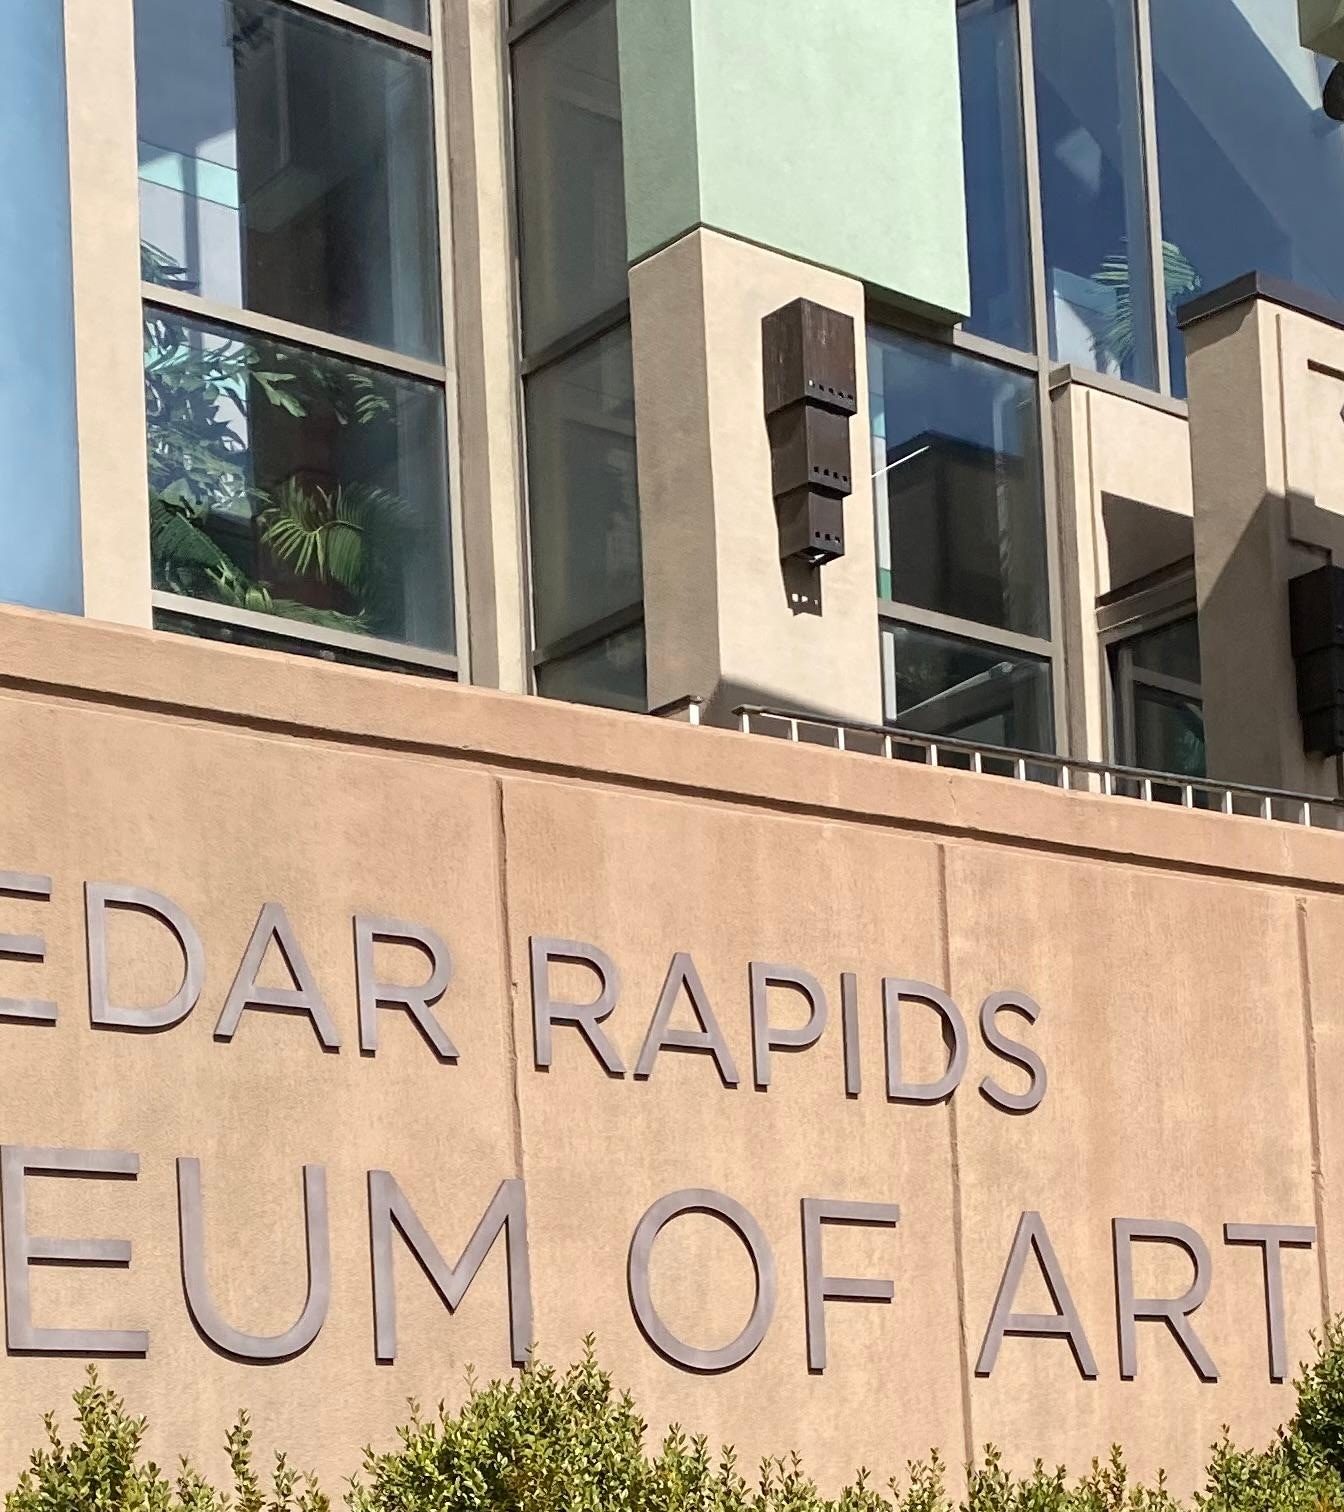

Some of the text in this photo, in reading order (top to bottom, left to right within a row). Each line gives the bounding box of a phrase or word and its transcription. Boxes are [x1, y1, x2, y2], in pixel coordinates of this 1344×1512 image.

[529, 935, 1047, 1113] RAPIDS
[628, 1187, 901, 1373] OF
[975, 1210, 1316, 1381] ART
